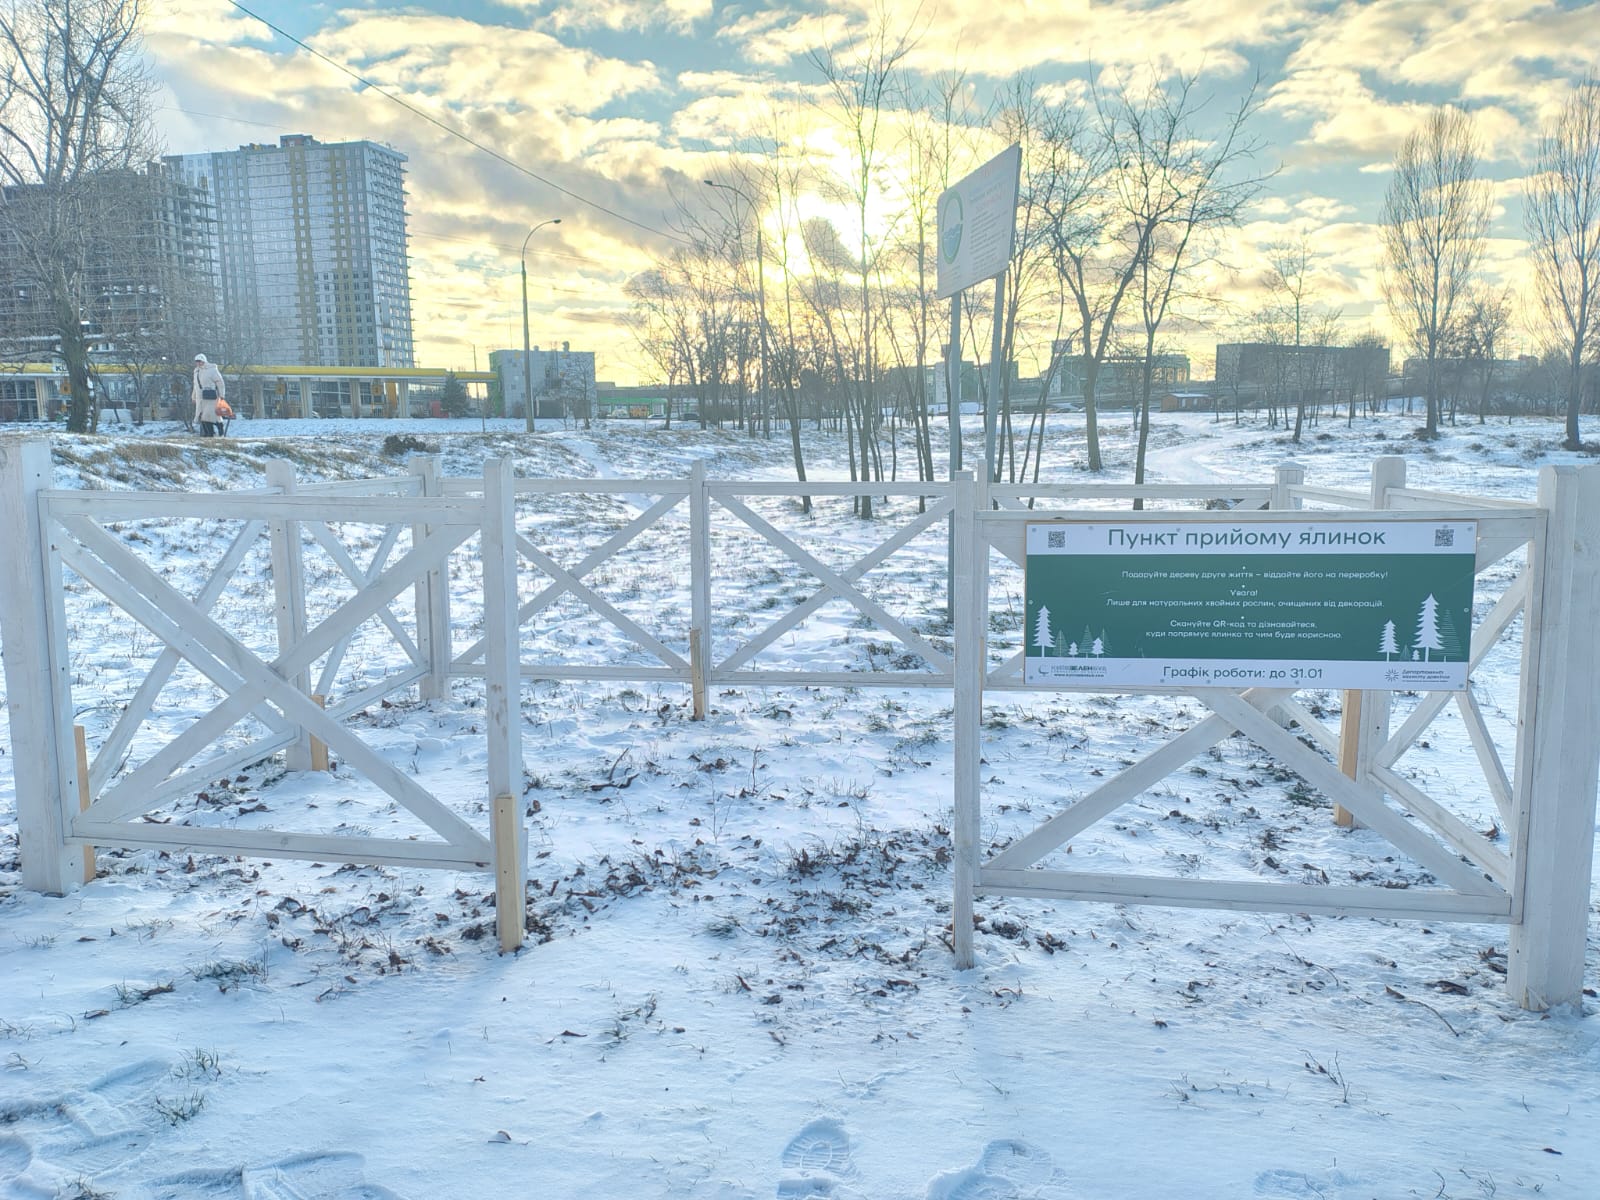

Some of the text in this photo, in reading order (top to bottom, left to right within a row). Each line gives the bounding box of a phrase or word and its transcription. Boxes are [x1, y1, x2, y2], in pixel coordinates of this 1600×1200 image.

[1108, 528, 1386, 549] Пункт прийому ялинок
[1121, 570, 1168, 579] Подаруйте
[1169, 571, 1200, 580] дереву
[1201, 571, 1226, 580] друге
[1263, 571, 1301, 579] віддайте
[1338, 570, 1389, 580] переробку!
[1230, 589, 1258, 597] Увага!
[1323, 600, 1336, 608] від
[1337, 600, 1385, 608] декорацій.
[1170, 620, 1211, 629] Скануйте
[1212, 620, 1245, 628] QR-код
[1167, 631, 1209, 639] попрямує
[1274, 631, 1296, 639] буде
[1163, 666, 1323, 679] Графік роботи: до 31.01
